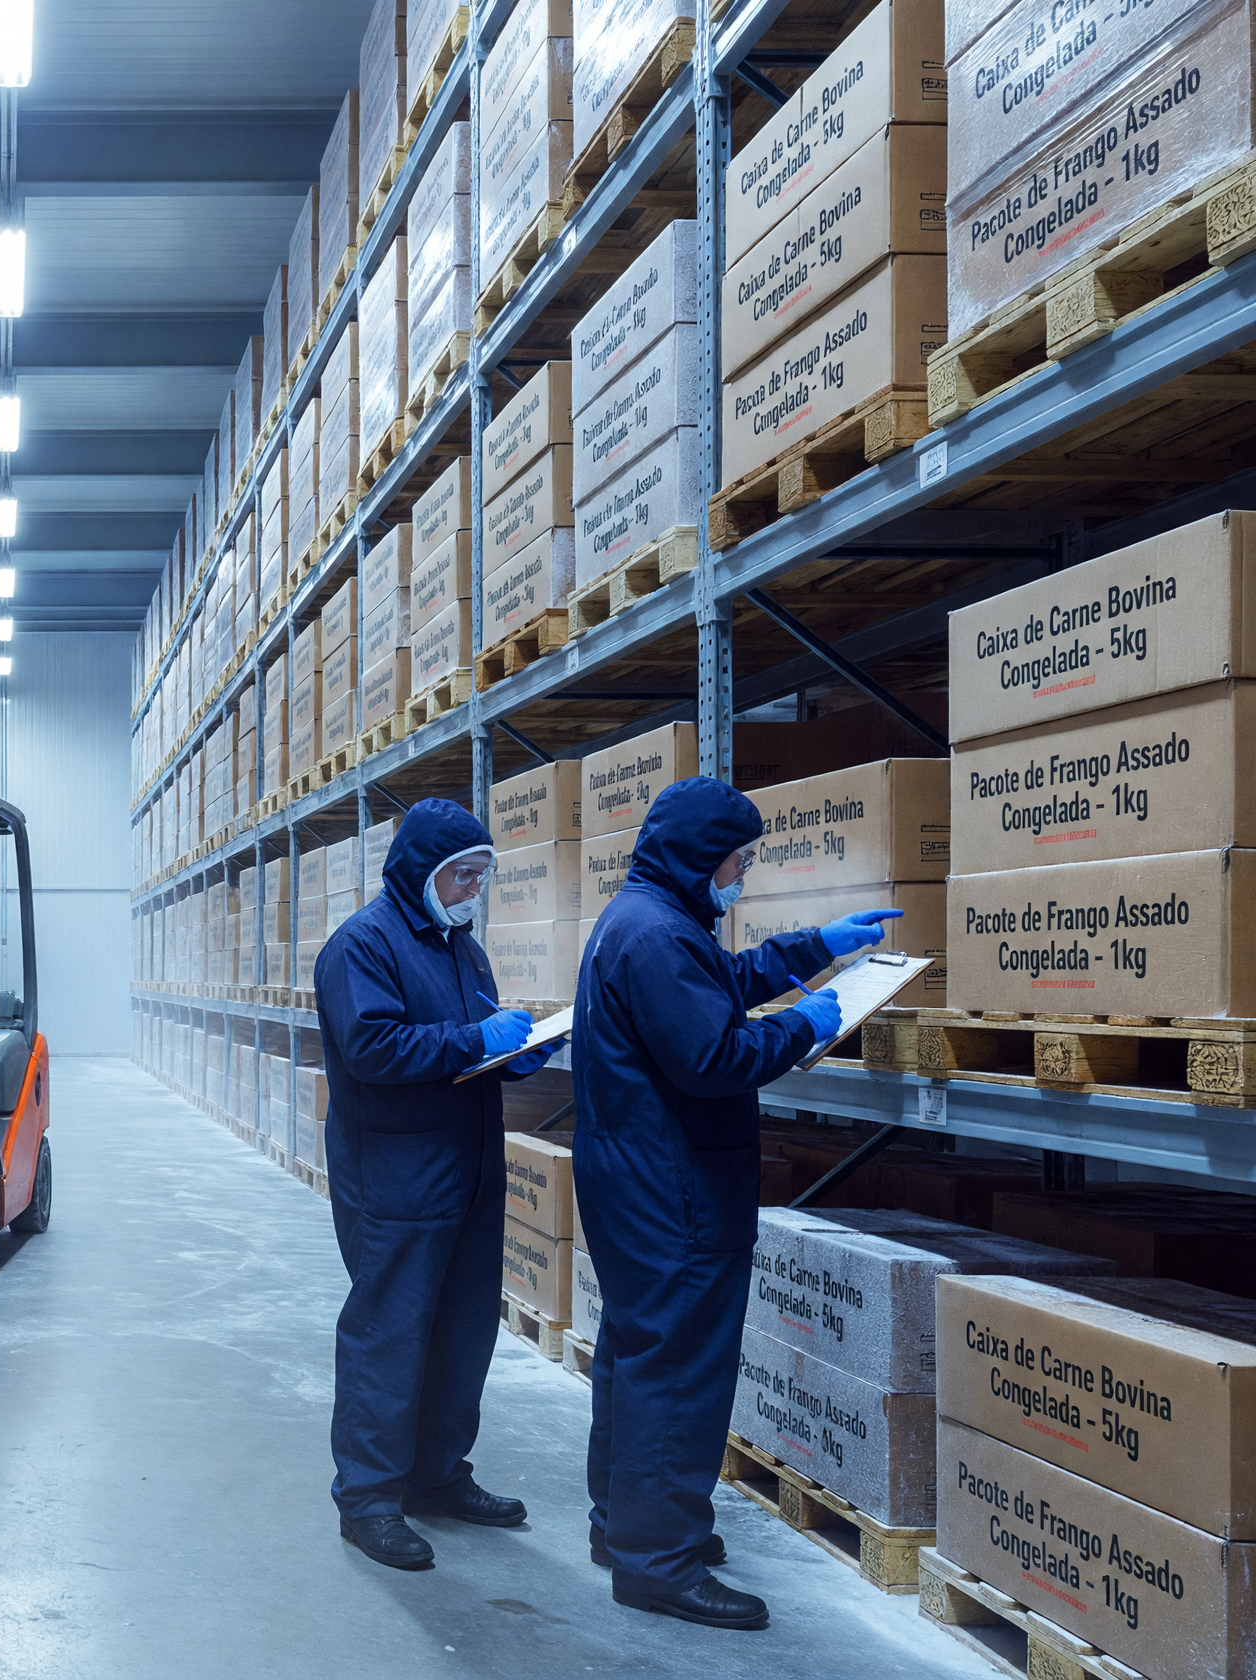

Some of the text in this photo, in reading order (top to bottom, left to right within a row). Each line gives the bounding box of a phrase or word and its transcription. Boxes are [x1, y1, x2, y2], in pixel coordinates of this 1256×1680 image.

[975, 47, 1019, 99] Caixa
[1024, 21, 1046, 57] de
[1002, 19, 1097, 114] Congelada
[971, 66, 1201, 251] Pacote de Frango Assado
[1003, 178, 1098, 263] Congelada
[1121, 139, 1159, 182] 1kg
[768, 254, 780, 279] de
[783, 225, 815, 265] Carne
[819, 186, 861, 236] Bovina
[976, 574, 1176, 659] Caixa de Carne Bovina
[1000, 638, 1090, 690] Congelada
[1110, 623, 1146, 661] 5kg
[970, 731, 1189, 800] Pacote de Frango Assado
[775, 809, 787, 833] de
[790, 805, 821, 831] Carne
[824, 796, 864, 825] Bovina
[823, 830, 845, 861] 5kg
[1001, 790, 1090, 835] Congelada
[1111, 782, 1148, 821] 1kg
[966, 892, 1189, 938] Pacote de Frango Assado
[998, 939, 1089, 978] Congelada
[1110, 938, 1146, 979] 1kg
[965, 1320, 1172, 1422] Caixa de Carne Bovina
[990, 1366, 1080, 1429] Congelada
[1101, 1407, 1139, 1462] 5kg
[958, 1460, 1184, 1600] Pacote de Frango Assado
[989, 1514, 1080, 1590] Congelada
[1101, 1574, 1138, 1630] 1kg
